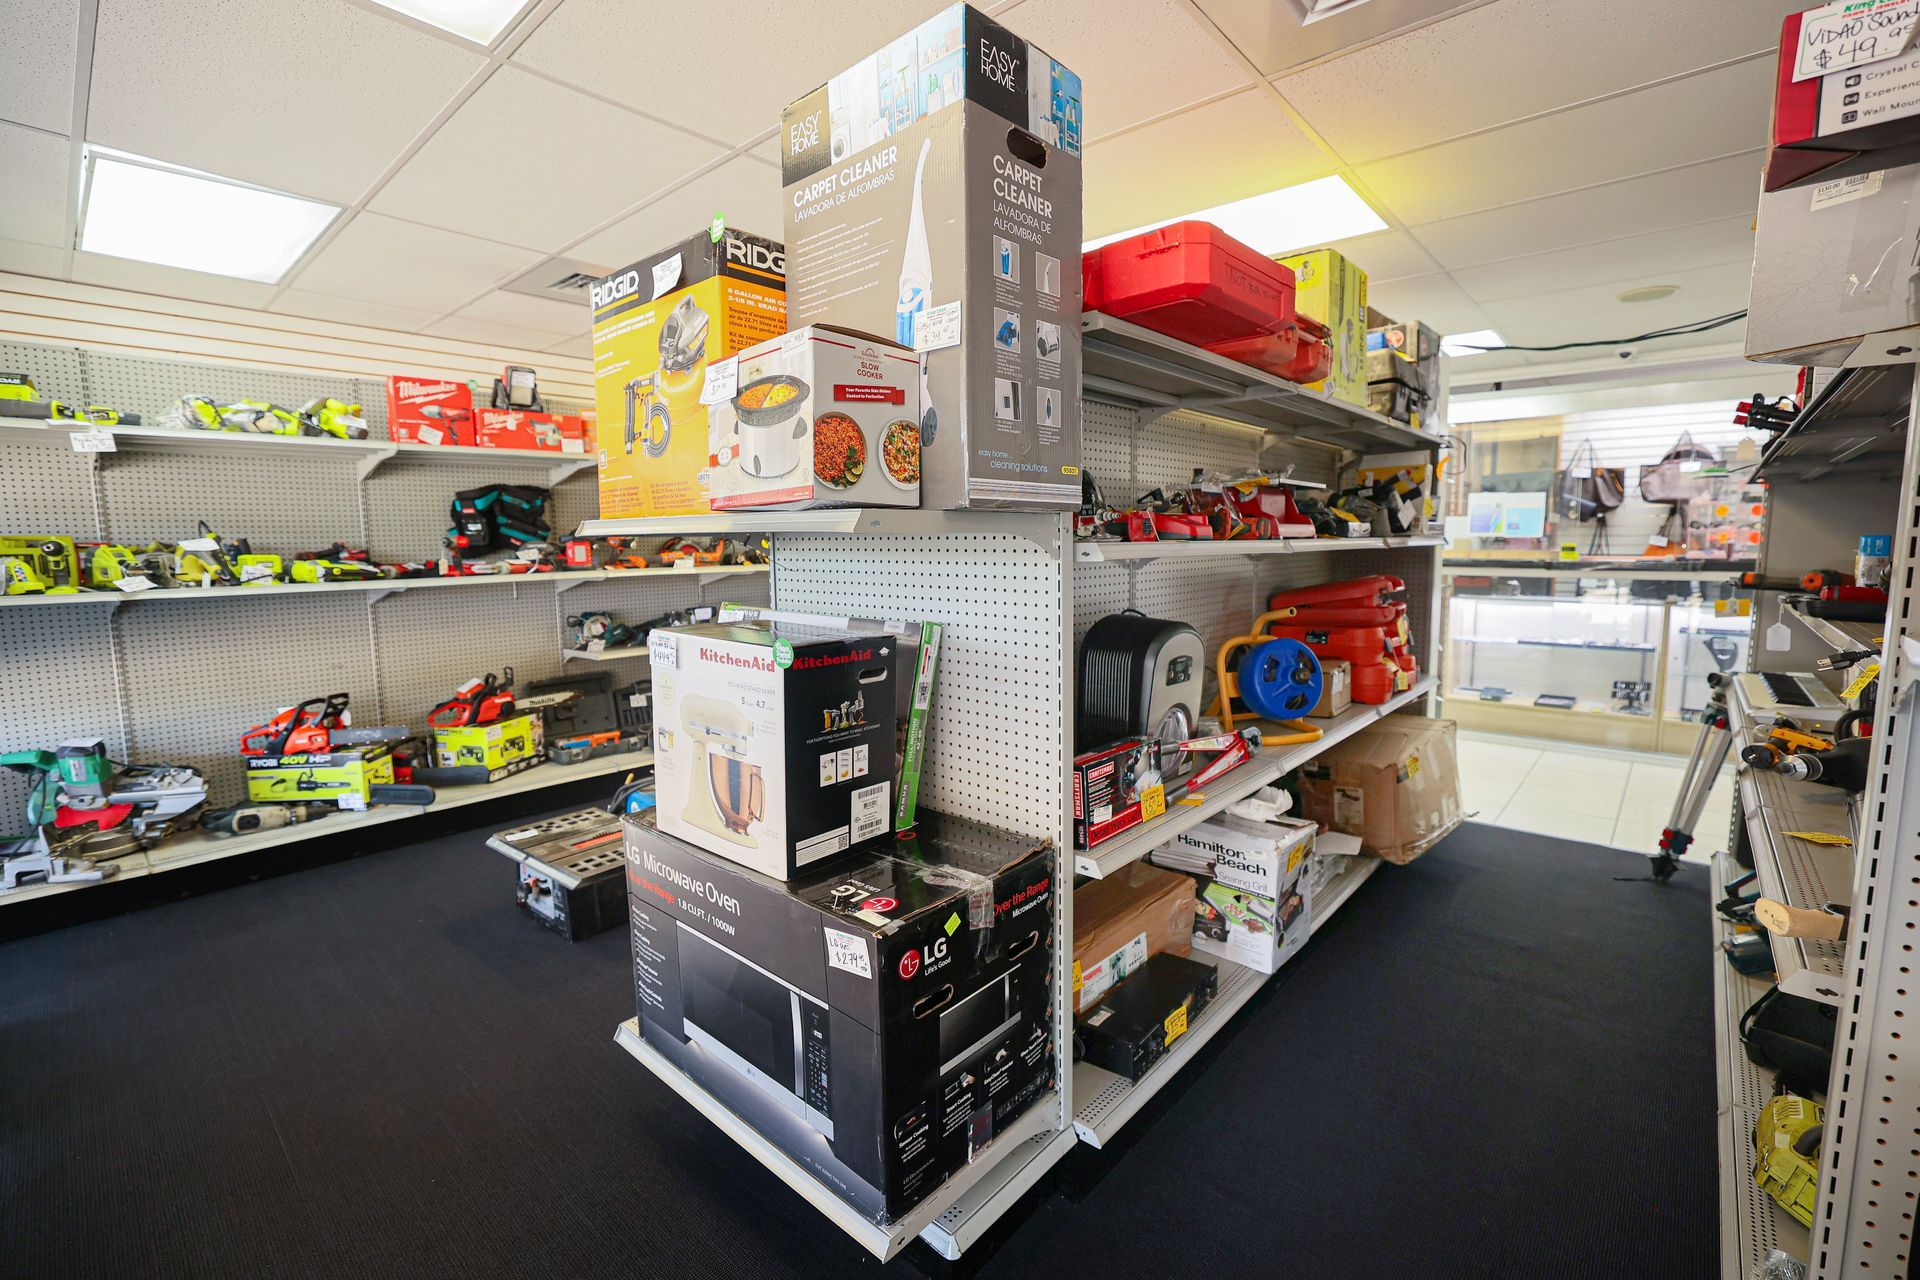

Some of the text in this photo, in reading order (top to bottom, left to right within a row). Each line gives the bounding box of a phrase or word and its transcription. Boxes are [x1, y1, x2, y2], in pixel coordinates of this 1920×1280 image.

[981, 38, 1016, 76] EASY
[981, 58, 1015, 92] HOME
[1866, 64, 1907, 81] Crystal
[1862, 105, 1886, 117] Wall
[791, 111, 819, 143] EASY
[791, 130, 819, 156] HOME
[793, 146, 897, 208] CARPET CLEANER
[993, 154, 1042, 193] CARPET
[794, 169, 895, 223] LAVADORA DE ALFOMBRAS
[993, 177, 1053, 219] CLEANER
[993, 200, 1052, 235] LAVADORA DE
[993, 217, 1042, 245] ALFOMBRAS
[593, 270, 639, 310] RIDGID
[734, 289, 762, 301] GALLON
[764, 296, 776, 305] AIR
[758, 301, 777, 312] BRAD
[729, 330, 737, 338] Kit
[857, 368, 883, 380] COOKER
[861, 361, 879, 371] SLOW
[978, 449, 991, 458] easy
[990, 459, 1049, 473] cleaning solutions
[699, 647, 776, 673] KitchenAid
[793, 649, 873, 671] KitchenAid
[741, 696, 746, 706] 5
[755, 699, 766, 710] 4.7
[249, 758, 278, 768] RYOBI
[1089, 764, 1113, 779] CRAFTSMAN
[1177, 833, 1246, 861] Hamilton
[1216, 854, 1267, 877] Beach
[626, 841, 740, 917] LG Microwave Oven
[1219, 871, 1252, 890] Searing
[1252, 881, 1268, 894] Grill
[830, 884, 871, 903] LG
[1012, 890, 1026, 905] the
[1026, 878, 1049, 898] Range
[1012, 898, 1036, 919] Microwave
[1036, 891, 1049, 905] Oven
[677, 898, 687, 911] 1.8
[712, 916, 735, 937] 1000W
[924, 937, 947, 966] LG
[924, 955, 951, 977] Life's Good
